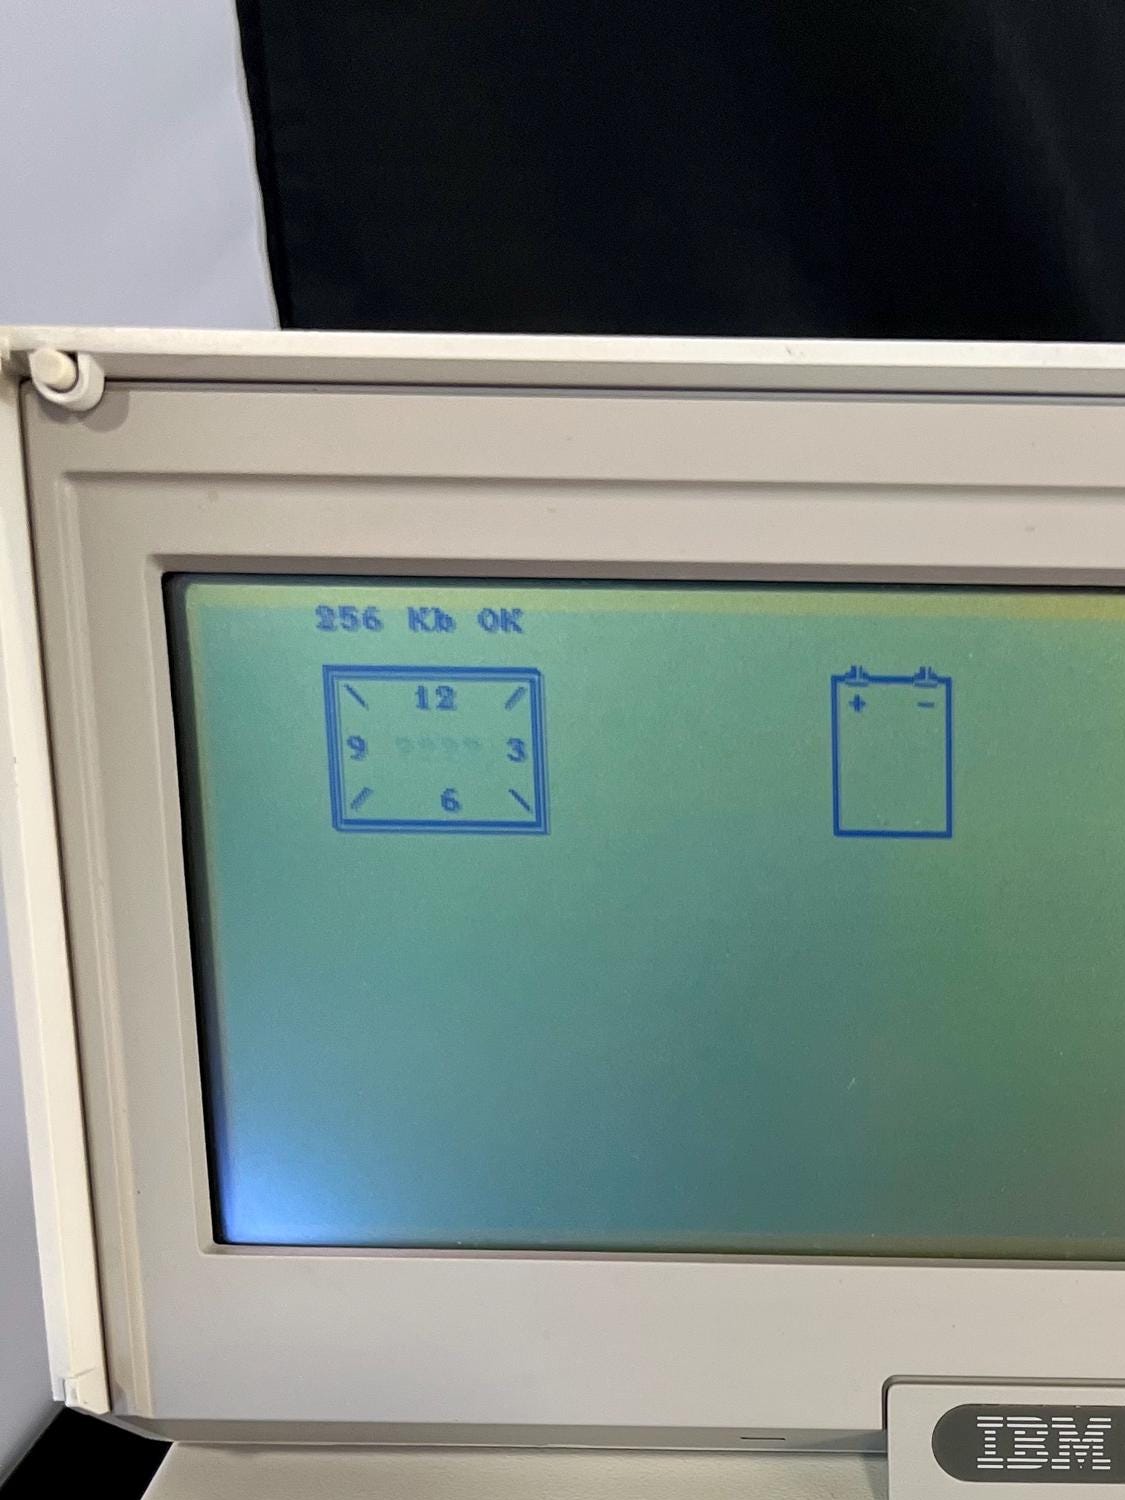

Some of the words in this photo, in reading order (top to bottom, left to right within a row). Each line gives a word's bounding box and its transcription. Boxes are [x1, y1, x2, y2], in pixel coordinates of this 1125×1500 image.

[316, 606, 382, 631] 256
[408, 607, 455, 632] Kb
[478, 608, 522, 633] OK
[416, 686, 454, 710] 12
[347, 736, 366, 759] 9
[507, 739, 525, 762] 3
[441, 788, 460, 811] 6
[977, 1417, 1111, 1469] IBM
